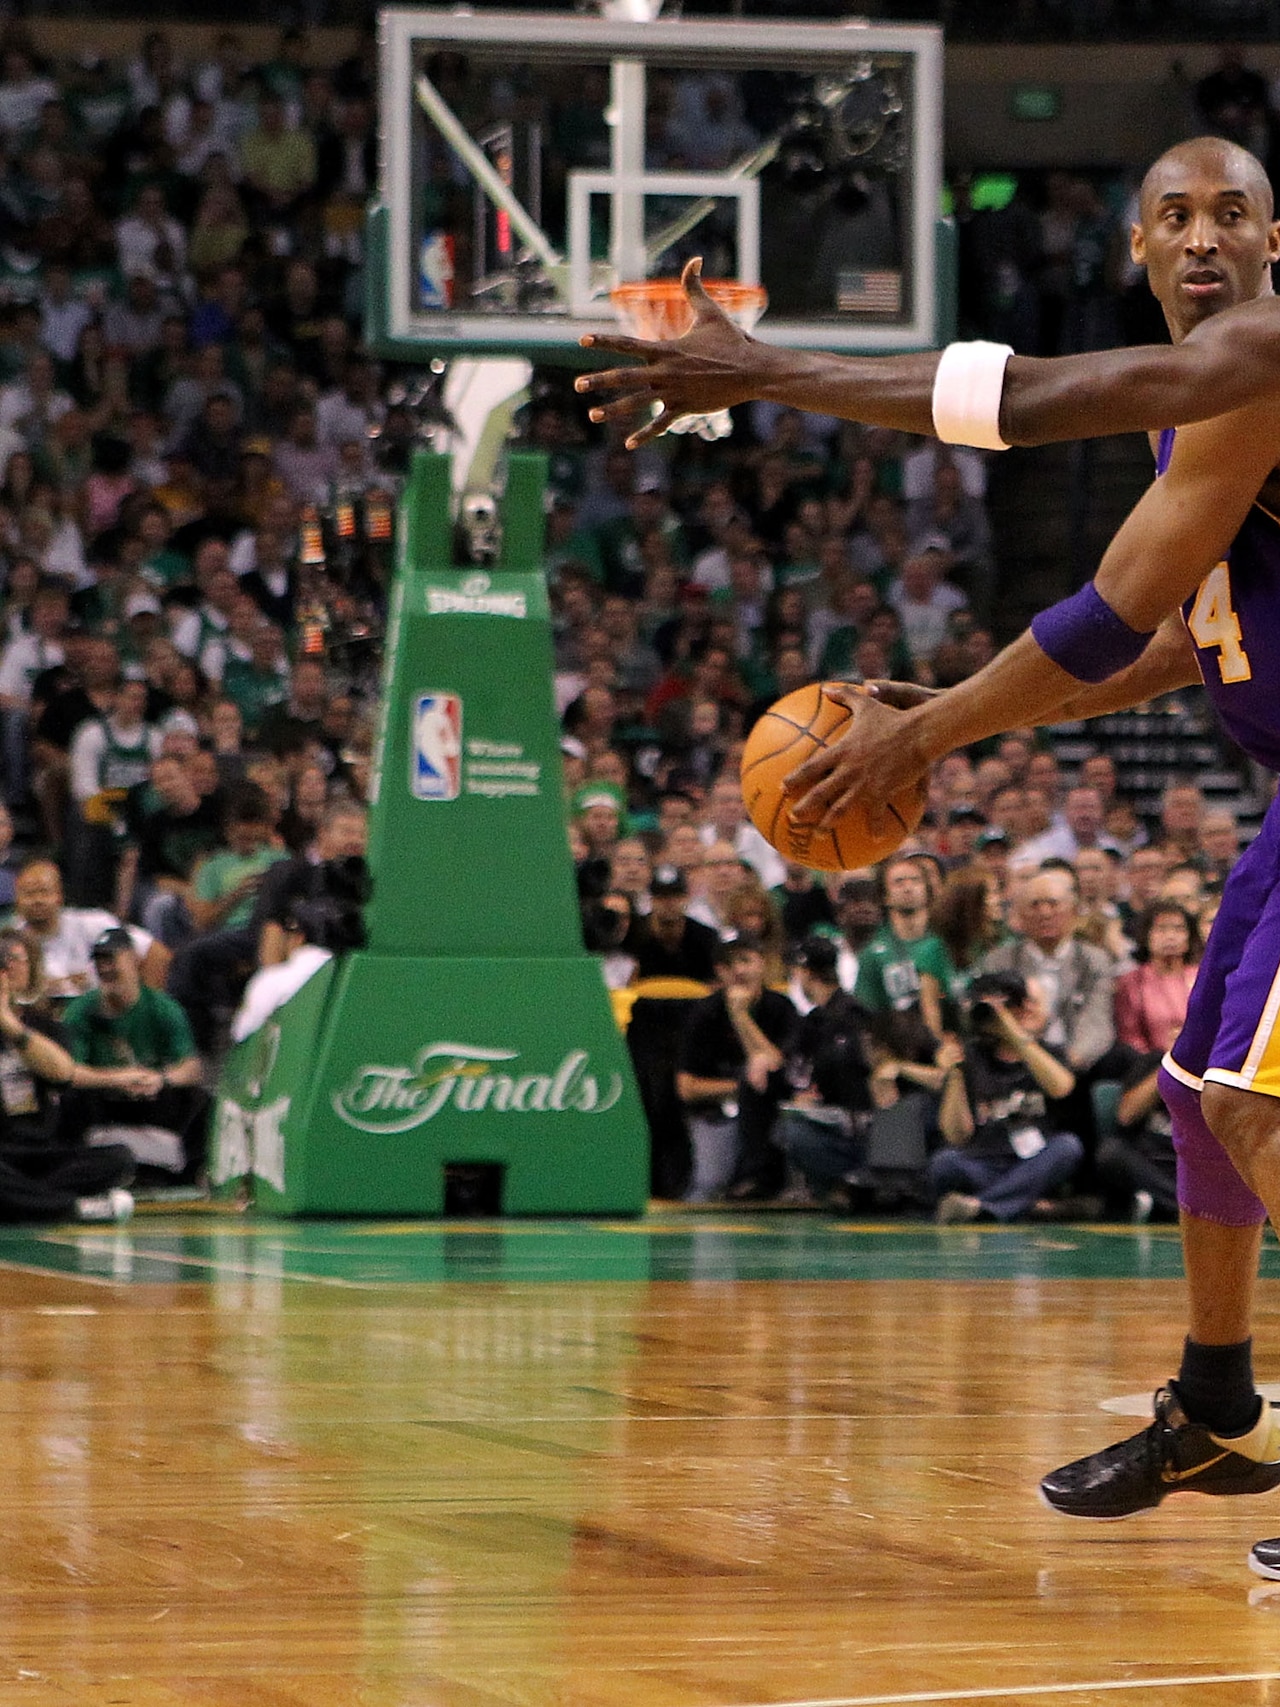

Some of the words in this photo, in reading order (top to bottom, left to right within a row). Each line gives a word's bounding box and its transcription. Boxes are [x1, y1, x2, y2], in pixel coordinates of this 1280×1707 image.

[1185, 560, 1252, 685] 4
[333, 1042, 622, 1134] Finals
[350, 1064, 424, 1112] The
